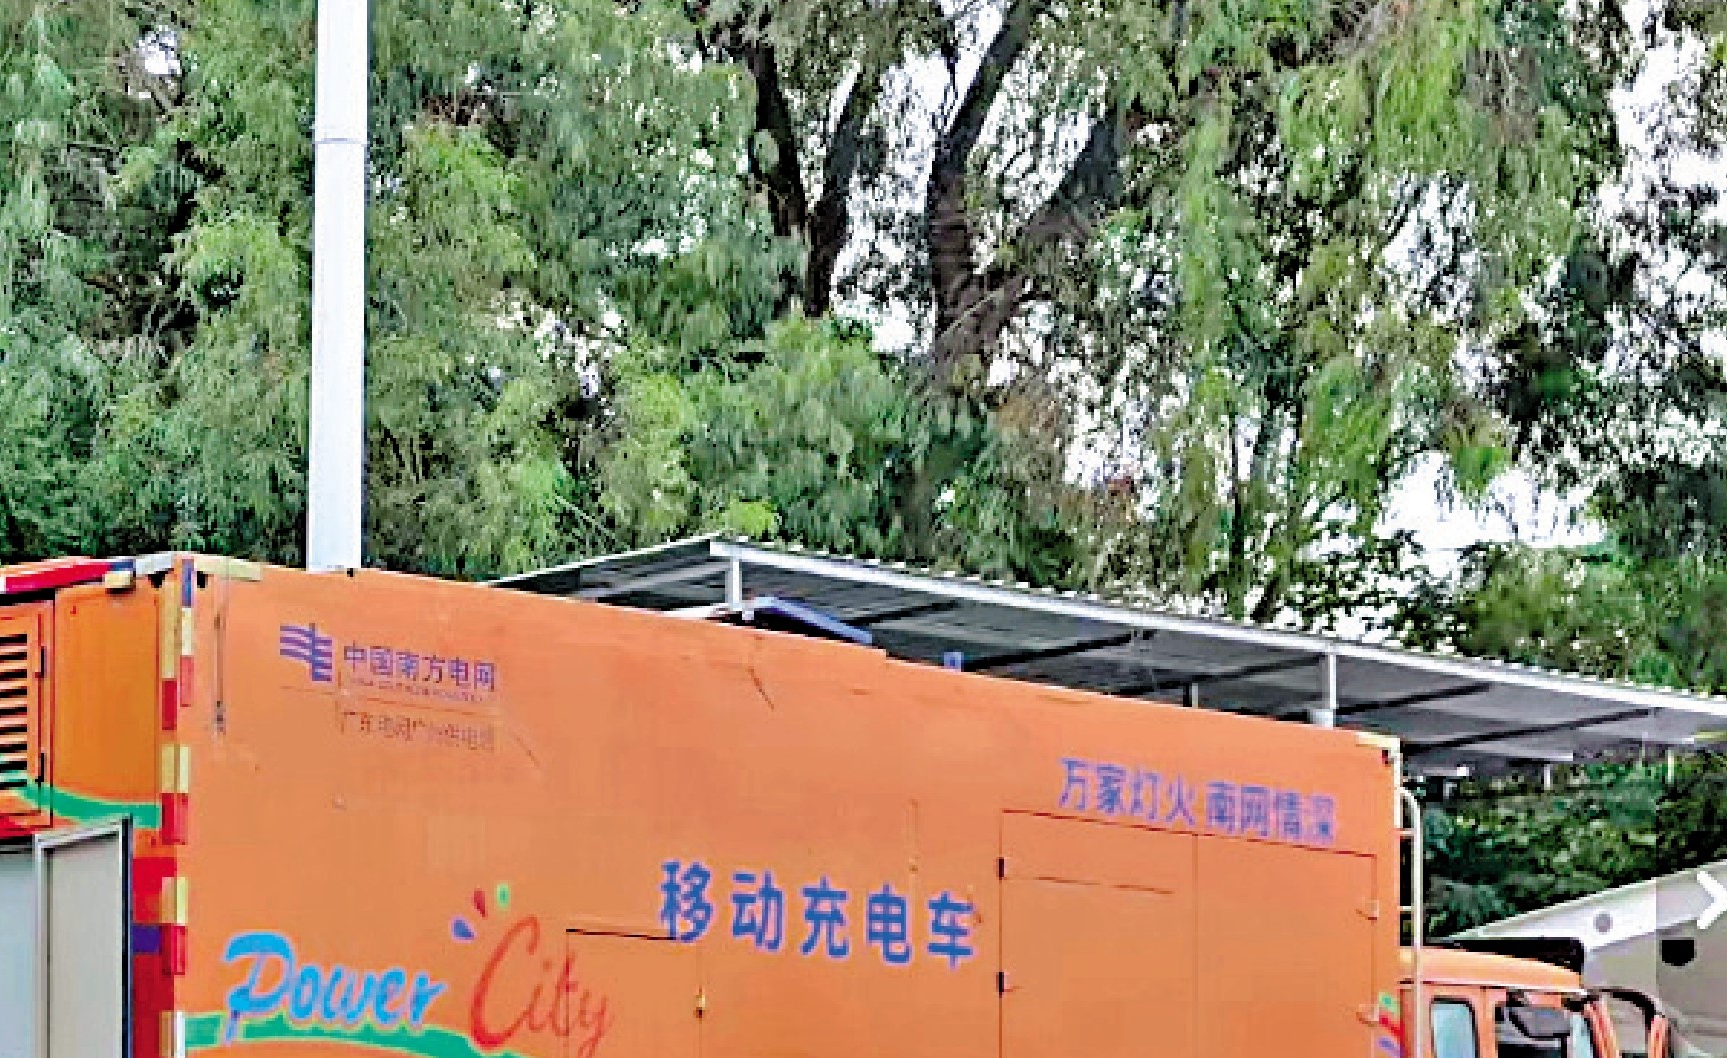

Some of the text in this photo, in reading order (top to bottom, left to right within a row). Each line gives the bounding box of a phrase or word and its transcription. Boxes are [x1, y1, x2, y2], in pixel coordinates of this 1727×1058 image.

[343, 638, 496, 692] 中国南方电网
[1058, 756, 1335, 842] 万家灯火 南网情深
[659, 858, 977, 967] 移动充电车
[223, 931, 448, 1044] Power
